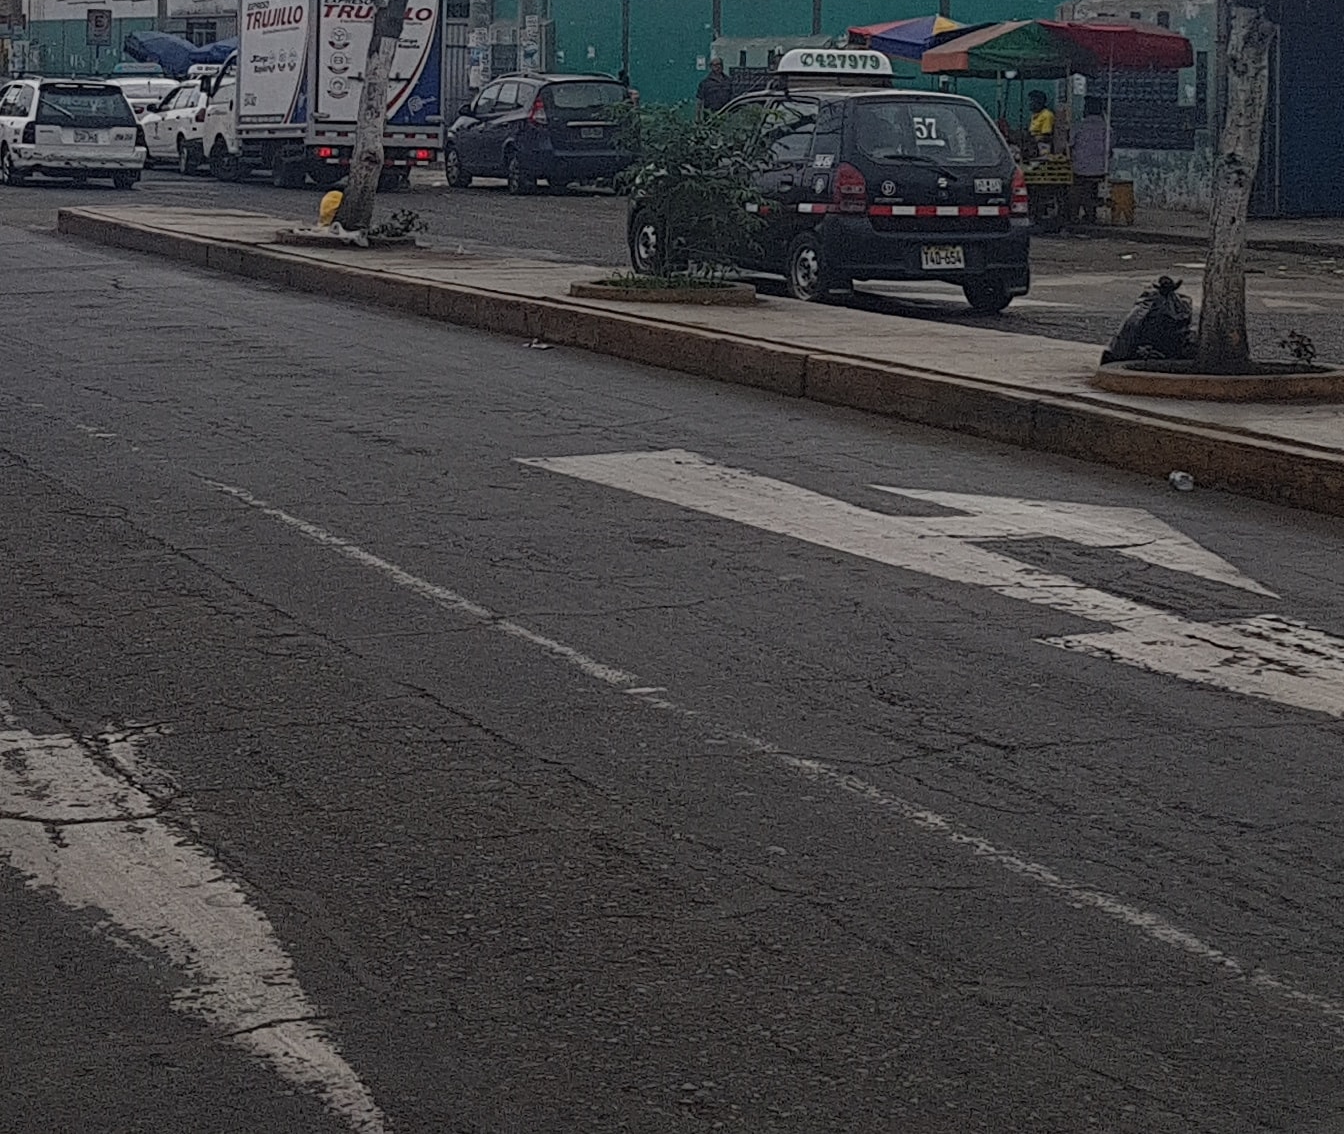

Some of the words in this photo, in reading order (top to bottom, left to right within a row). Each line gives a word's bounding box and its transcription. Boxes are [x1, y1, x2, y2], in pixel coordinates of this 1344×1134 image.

[246, 5, 304, 31] TRUJILLO
[323, 4, 433, 21] TRULO
[913, 117, 937, 139] 57
